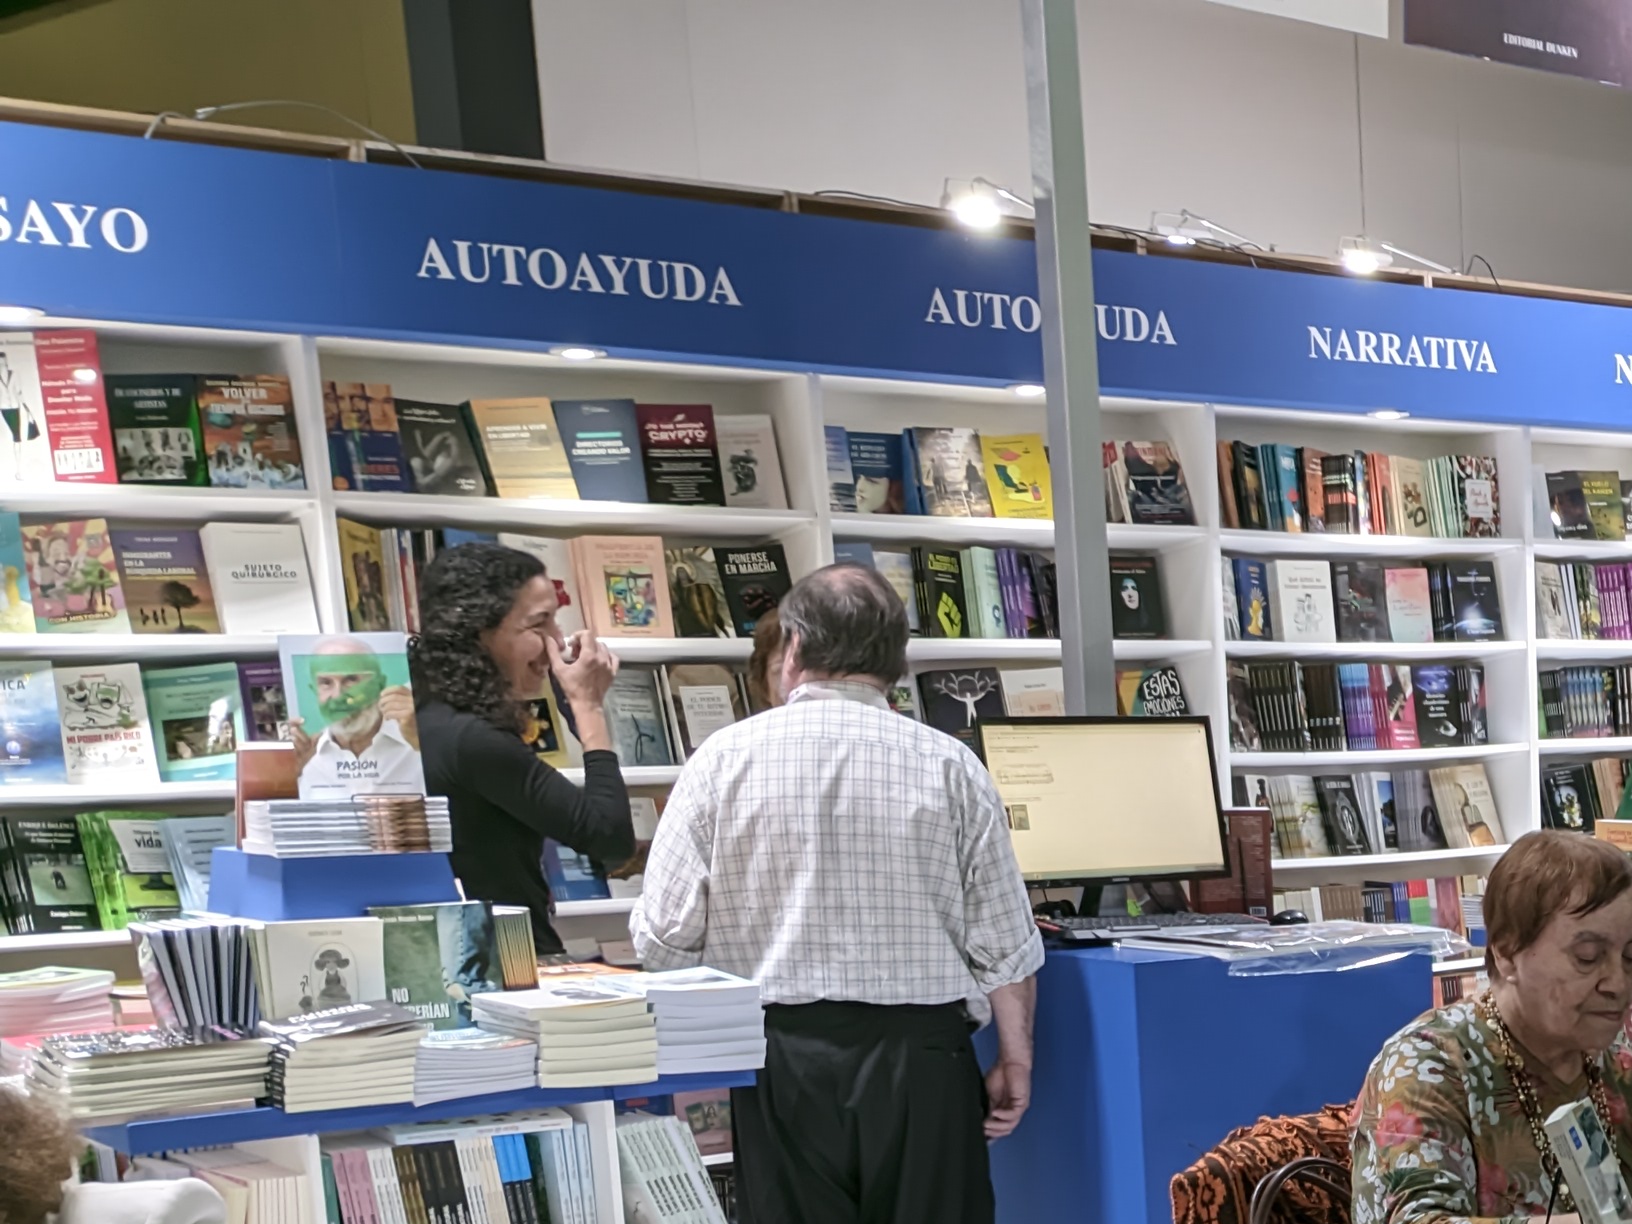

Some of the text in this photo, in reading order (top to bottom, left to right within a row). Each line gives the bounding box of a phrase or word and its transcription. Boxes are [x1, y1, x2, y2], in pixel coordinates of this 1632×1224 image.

[417, 237, 742, 307] AUTOAYUDA
[925, 287, 1177, 346] AUTOUDA
[1308, 326, 1498, 374] NARRATIVA
[727, 551, 768, 563] PONERSE
[243, 563, 283, 572] SUJETO
[724, 562, 778, 575] EN MARCHA
[1142, 670, 1181, 701] ESTAS
[335, 759, 378, 772] PASIÓN
[135, 831, 162, 849] vida
[391, 987, 410, 1004] NO
